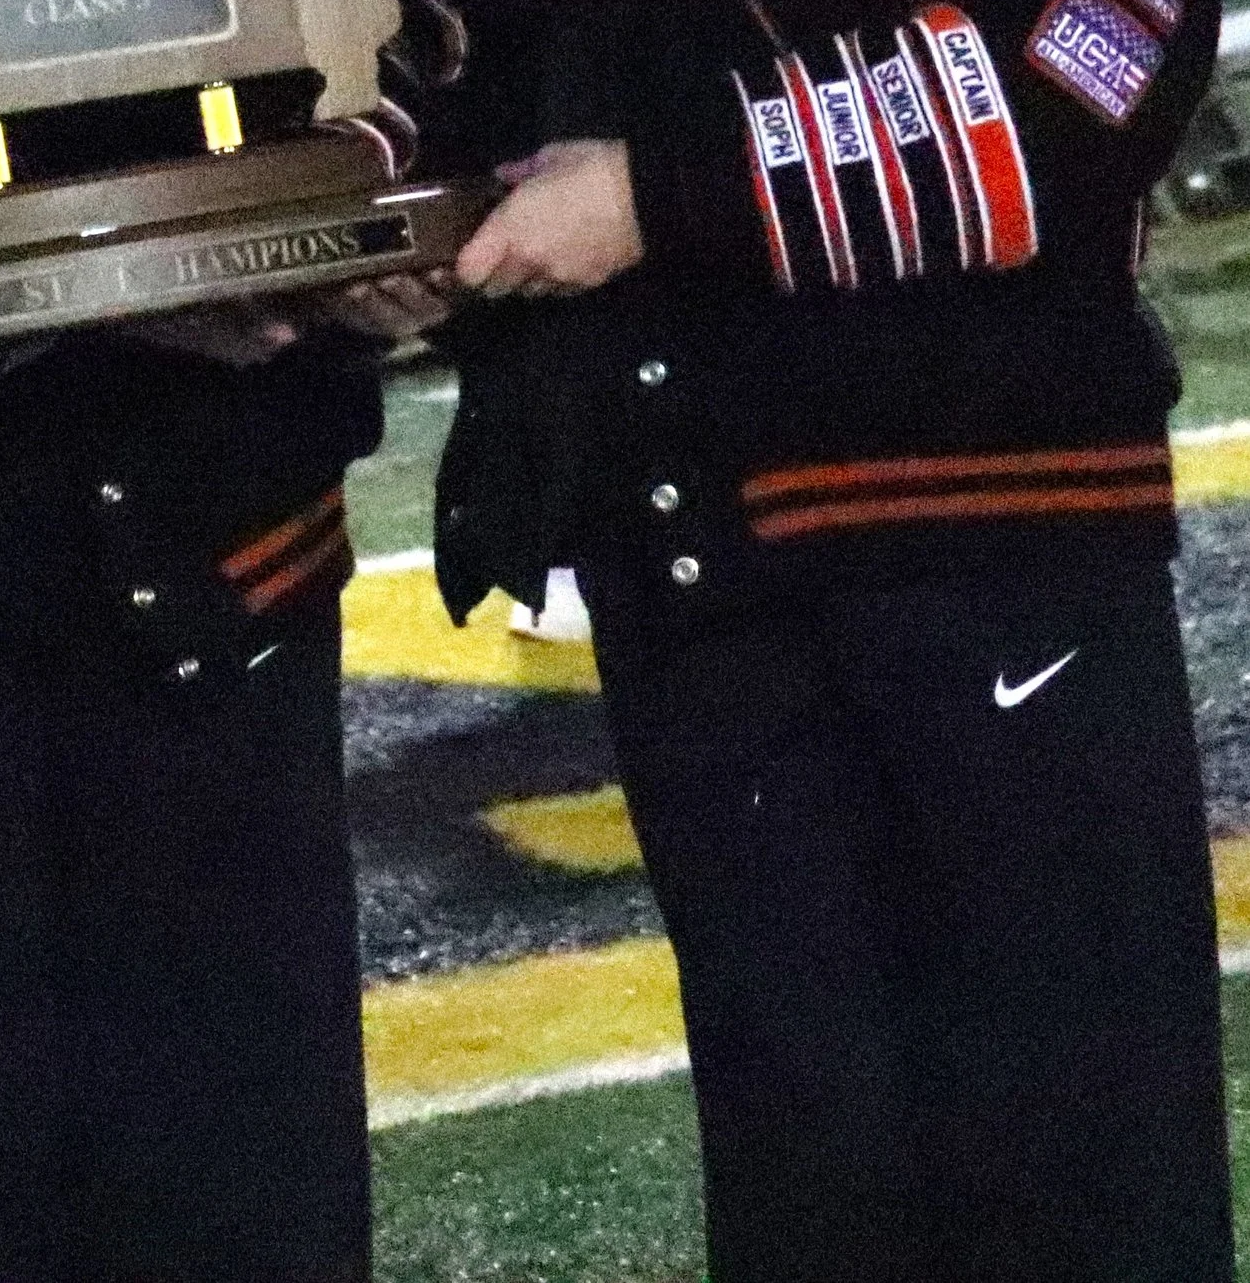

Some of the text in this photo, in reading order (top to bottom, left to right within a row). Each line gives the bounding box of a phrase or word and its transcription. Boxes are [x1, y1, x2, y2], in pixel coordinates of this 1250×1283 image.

[944, 32, 994, 121] CAPTAIN
[1054, 12, 1130, 89] UCA
[761, 103, 795, 159] SOPH
[823, 88, 861, 160] JUNIOR
[878, 63, 922, 141] SENIOR
[172, 227, 360, 284] HAMPIONS
